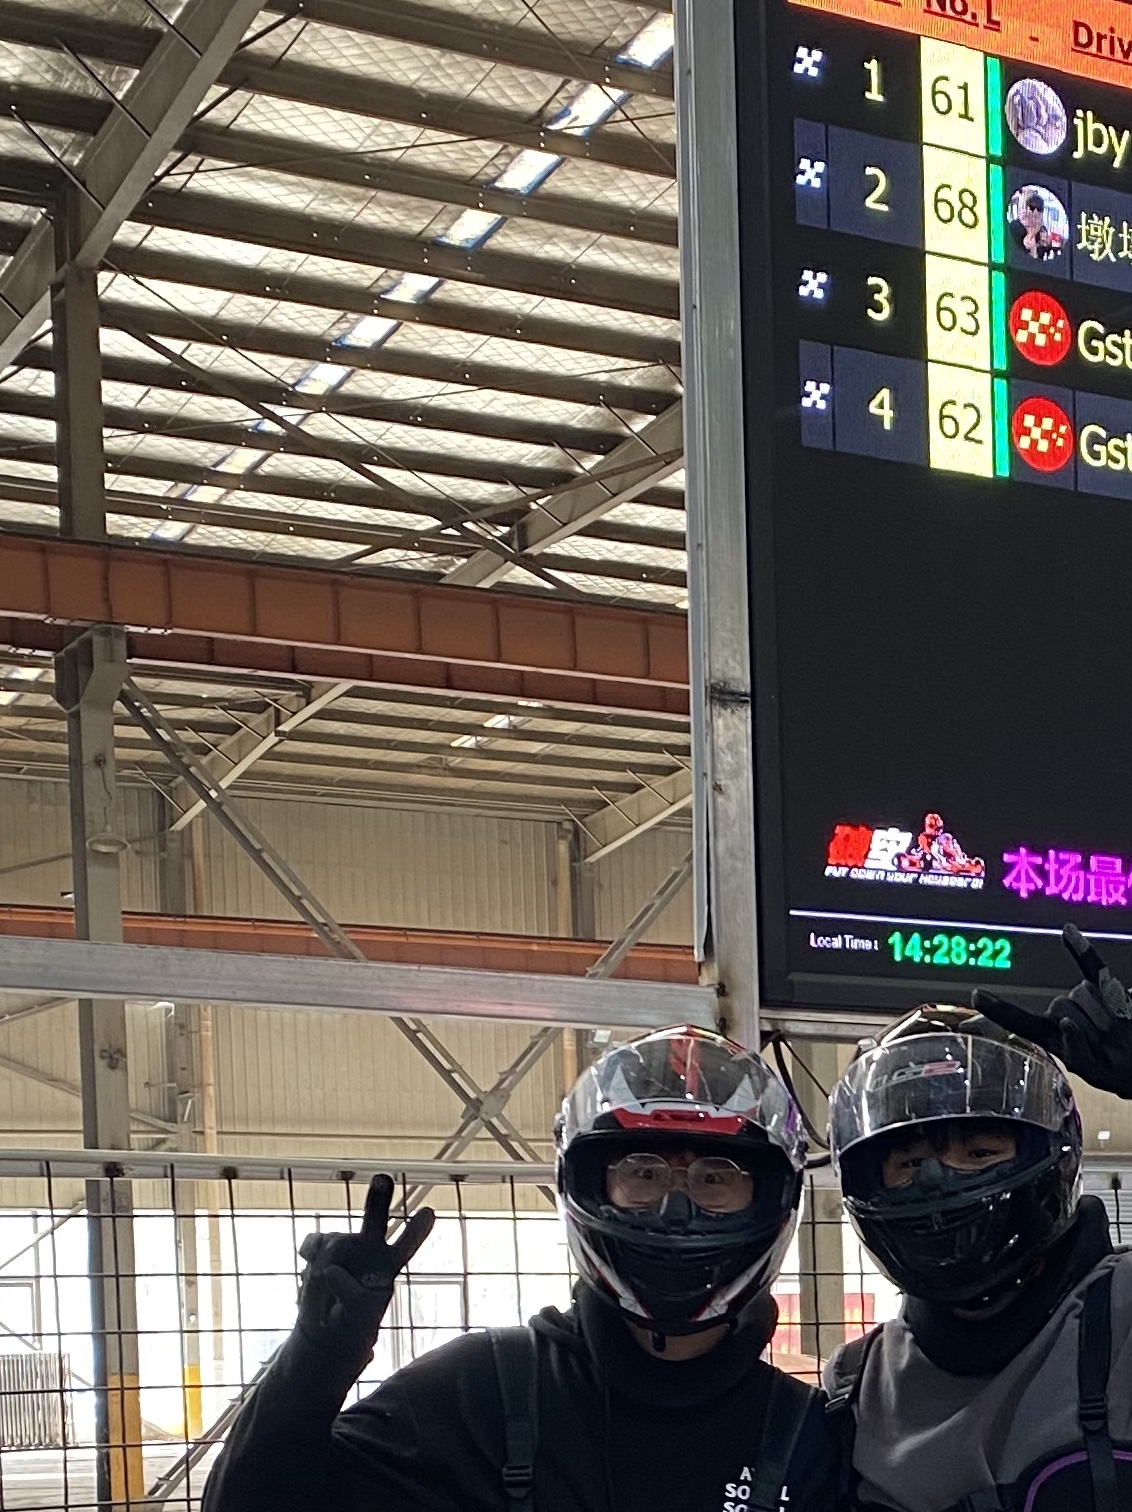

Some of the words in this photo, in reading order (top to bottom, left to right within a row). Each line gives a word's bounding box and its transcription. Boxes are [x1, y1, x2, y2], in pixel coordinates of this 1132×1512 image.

[863, 57, 885, 103] 1
[931, 75, 975, 123] 61
[1073, 109, 1131, 168] jby
[863, 166, 889, 212] 2
[933, 183, 979, 230] 68
[866, 276, 892, 322] 3
[935, 291, 980, 337] 63
[868, 387, 894, 431] 4
[938, 401, 984, 446] 62
[809, 932, 842, 949] Local
[888, 932, 1012, 969] 14:28:22
